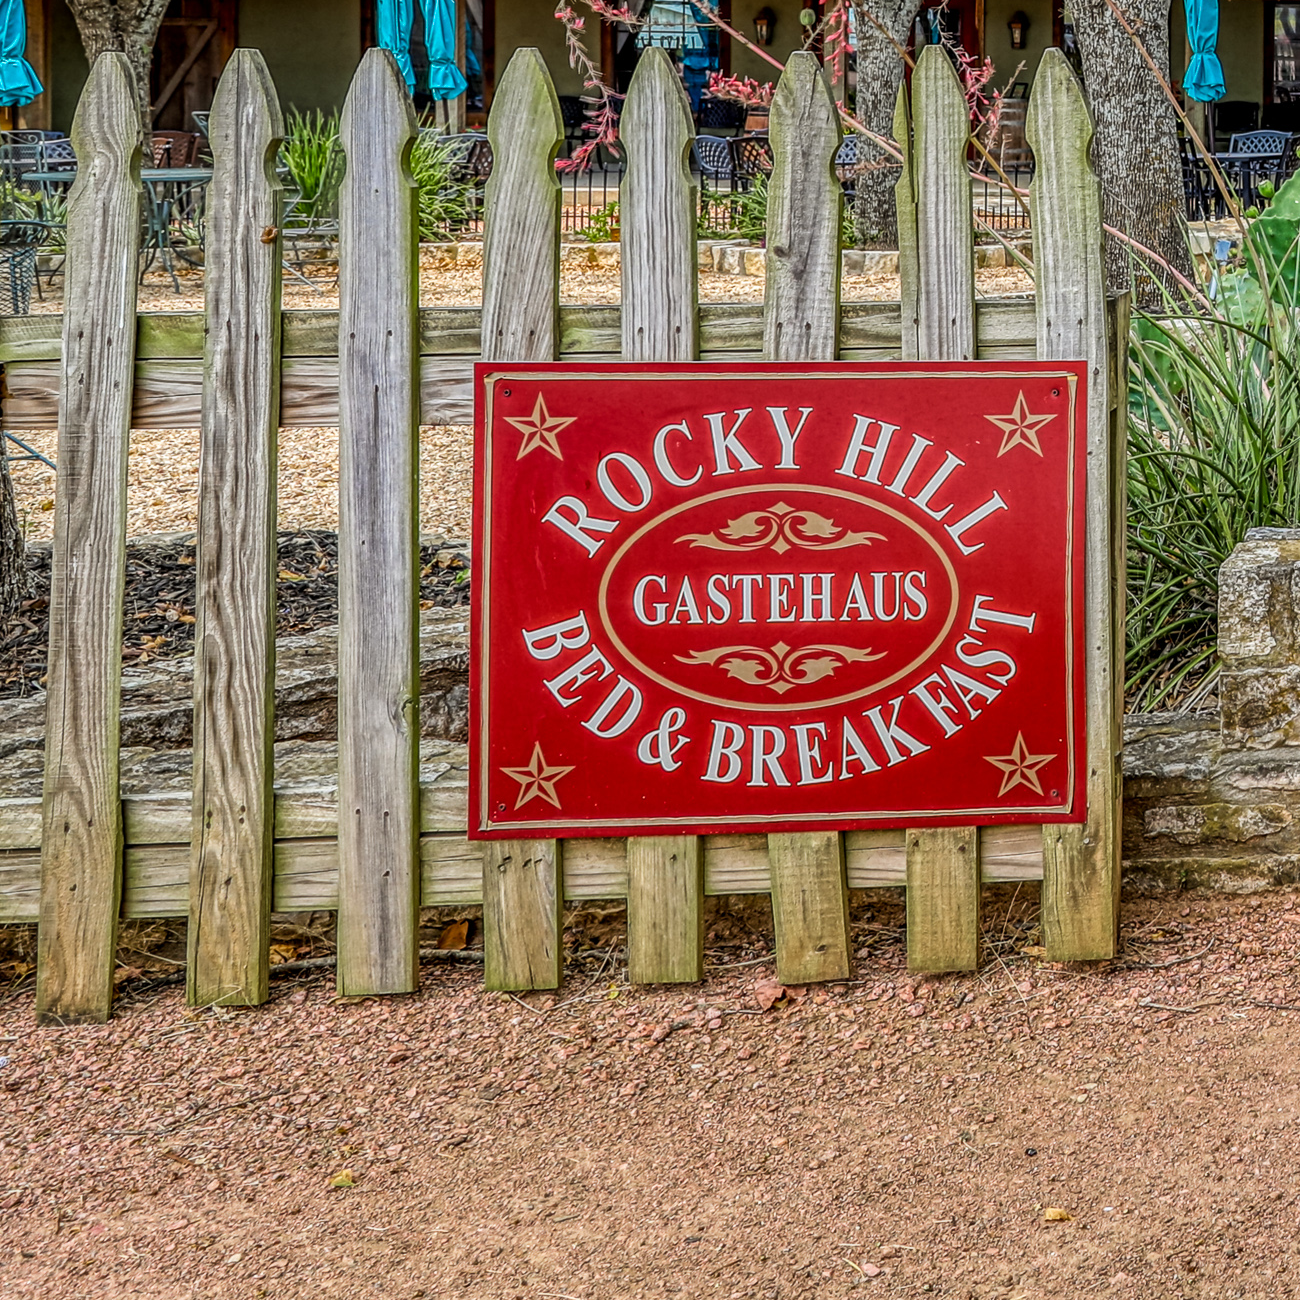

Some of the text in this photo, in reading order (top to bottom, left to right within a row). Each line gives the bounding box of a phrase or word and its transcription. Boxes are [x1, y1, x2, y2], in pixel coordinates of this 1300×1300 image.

[540, 406, 1009, 559] ROCKY HILL
[632, 570, 929, 626] GASTEHAUS
[521, 594, 1037, 788] BED & BREAKFAST
